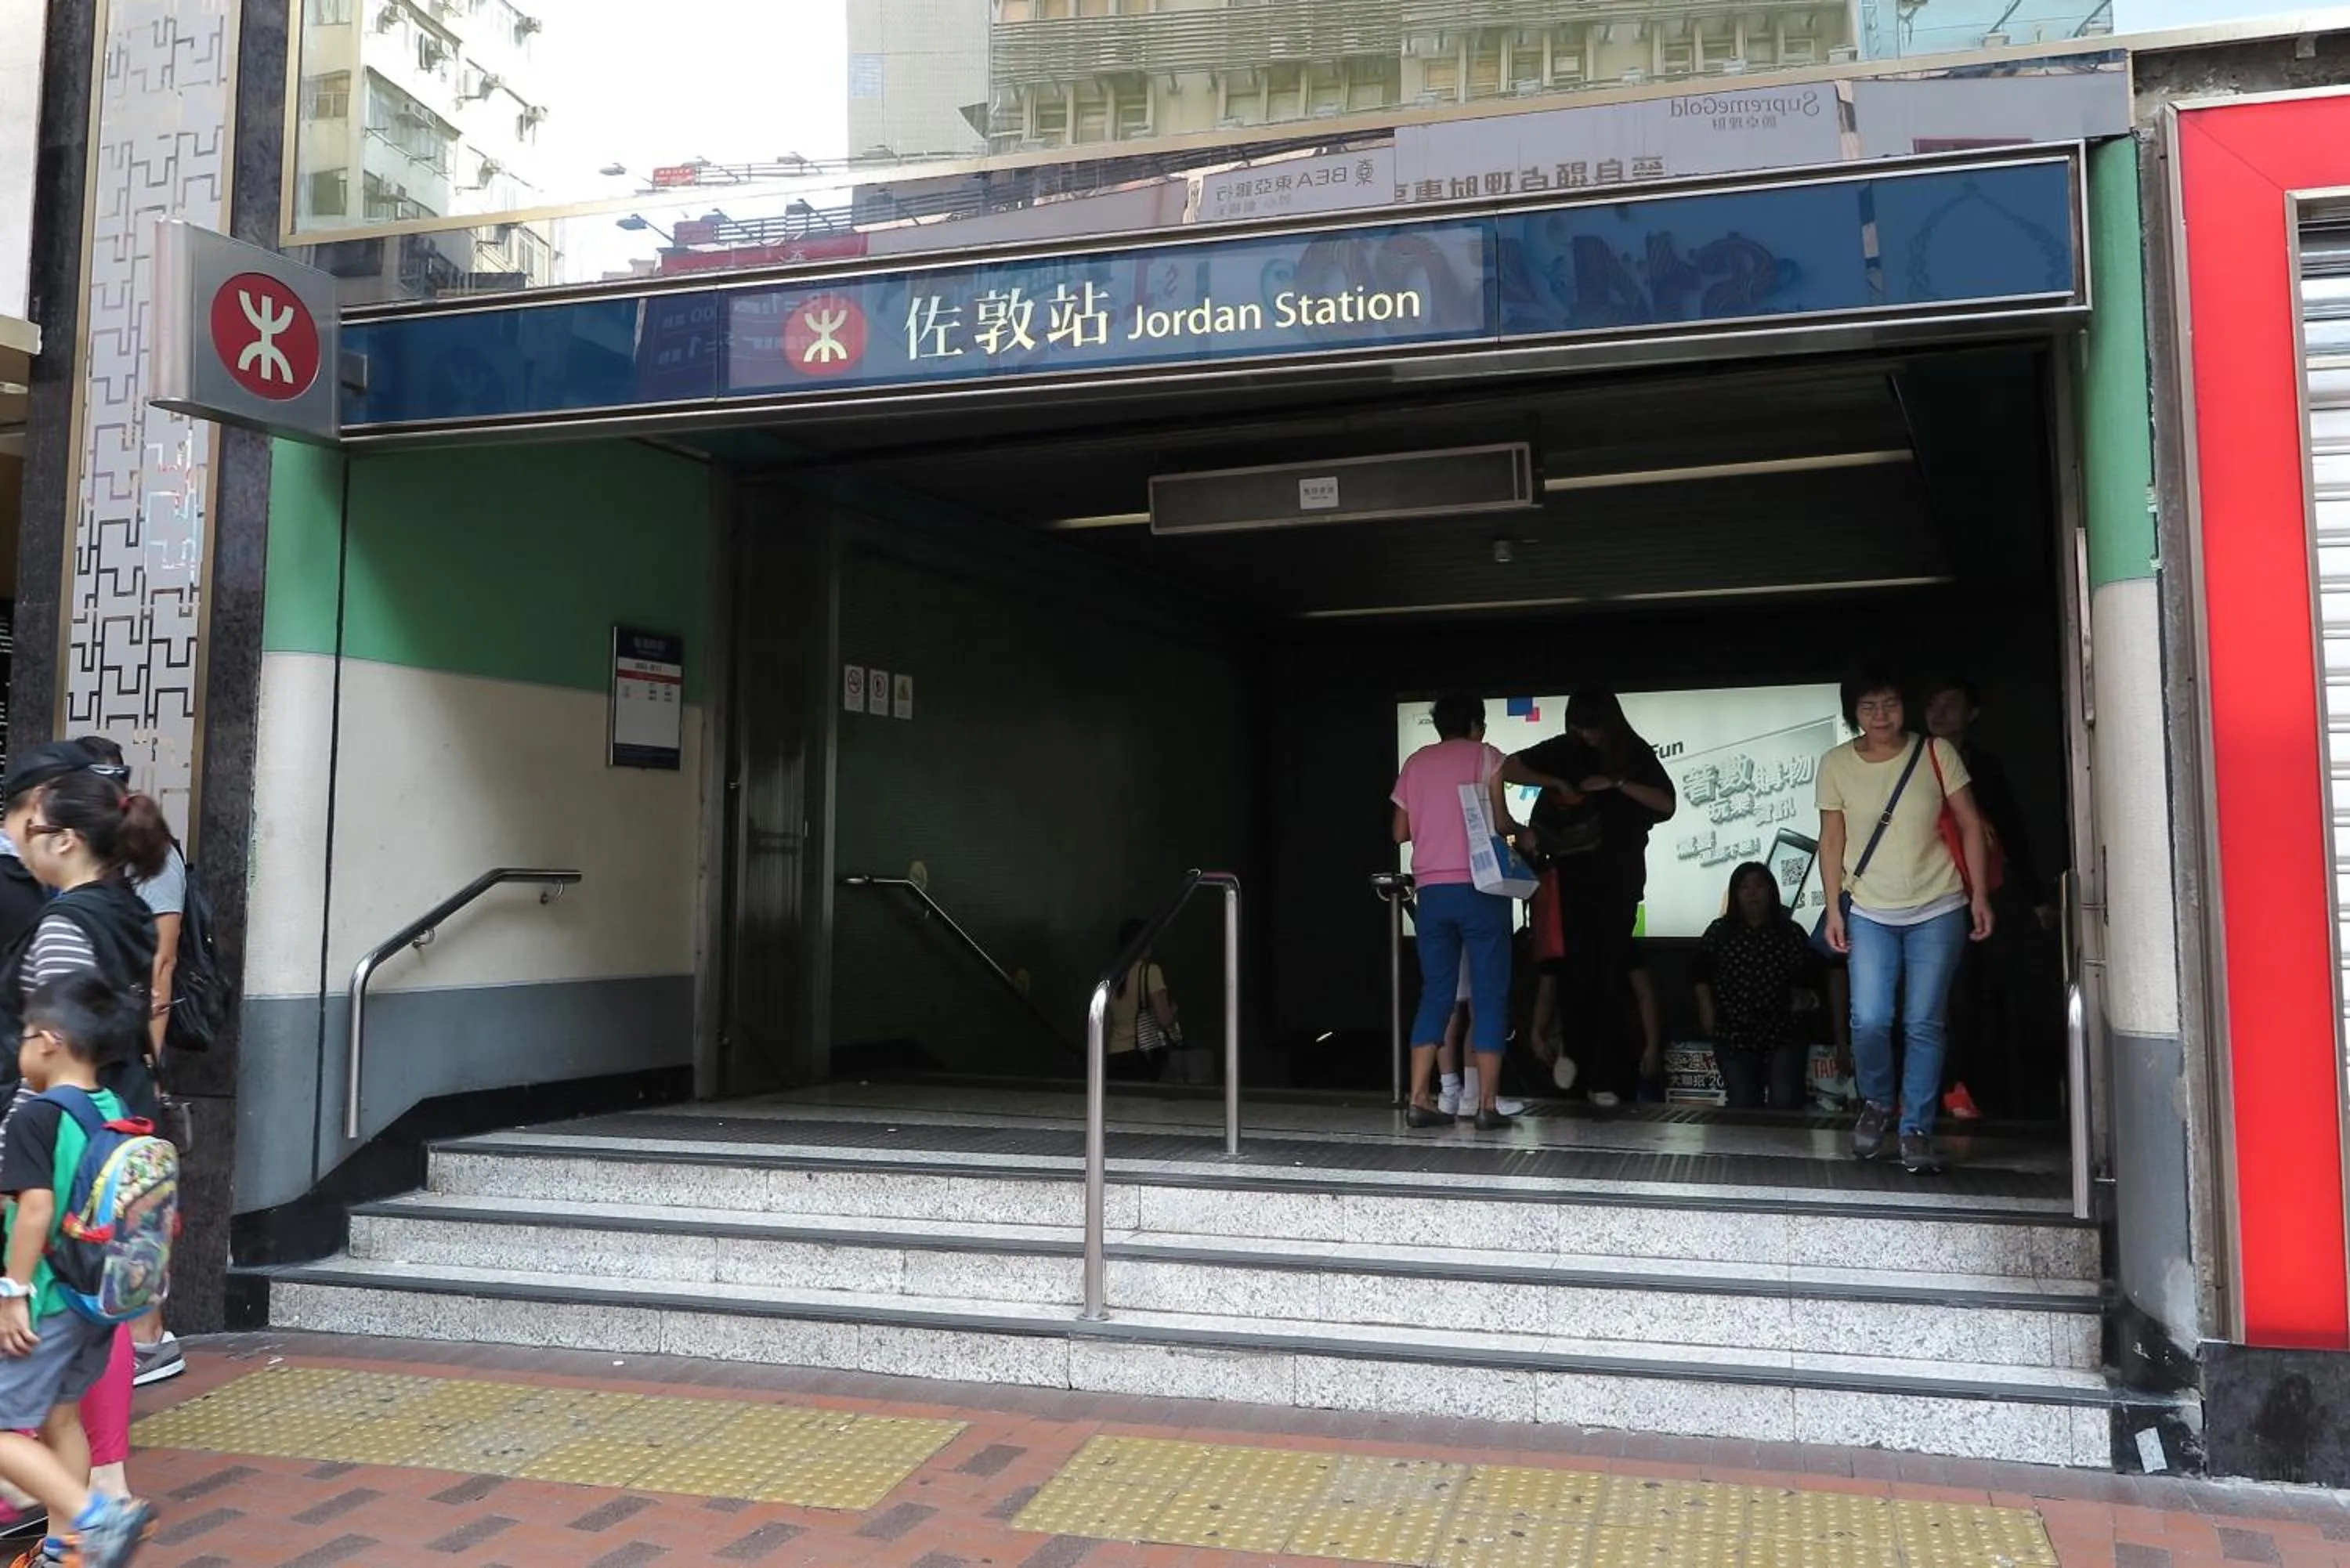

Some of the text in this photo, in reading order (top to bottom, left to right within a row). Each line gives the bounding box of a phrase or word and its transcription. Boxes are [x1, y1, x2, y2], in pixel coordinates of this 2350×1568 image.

[903, 281, 1420, 360] 佐敦站 Jordan Station
